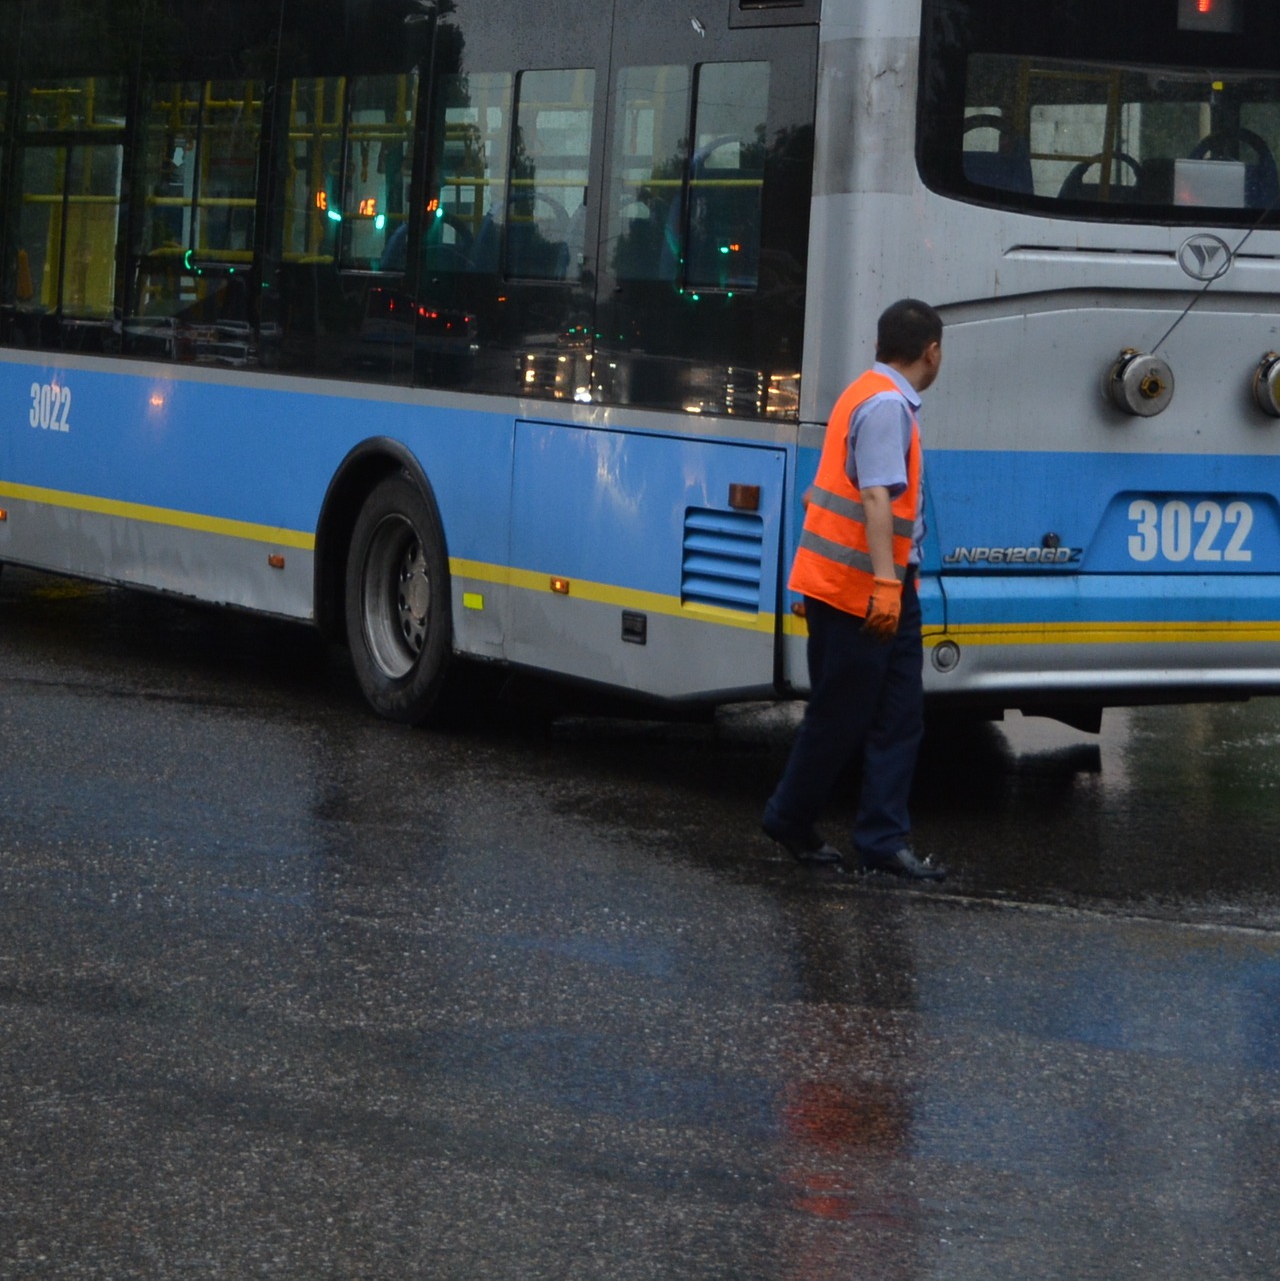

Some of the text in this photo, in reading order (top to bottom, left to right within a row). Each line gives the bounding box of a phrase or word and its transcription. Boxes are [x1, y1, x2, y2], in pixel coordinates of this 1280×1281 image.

[29, 382, 71, 432] 3022
[943, 547, 1083, 564] JNP6120GDZ
[1127, 500, 1254, 562] 3022
